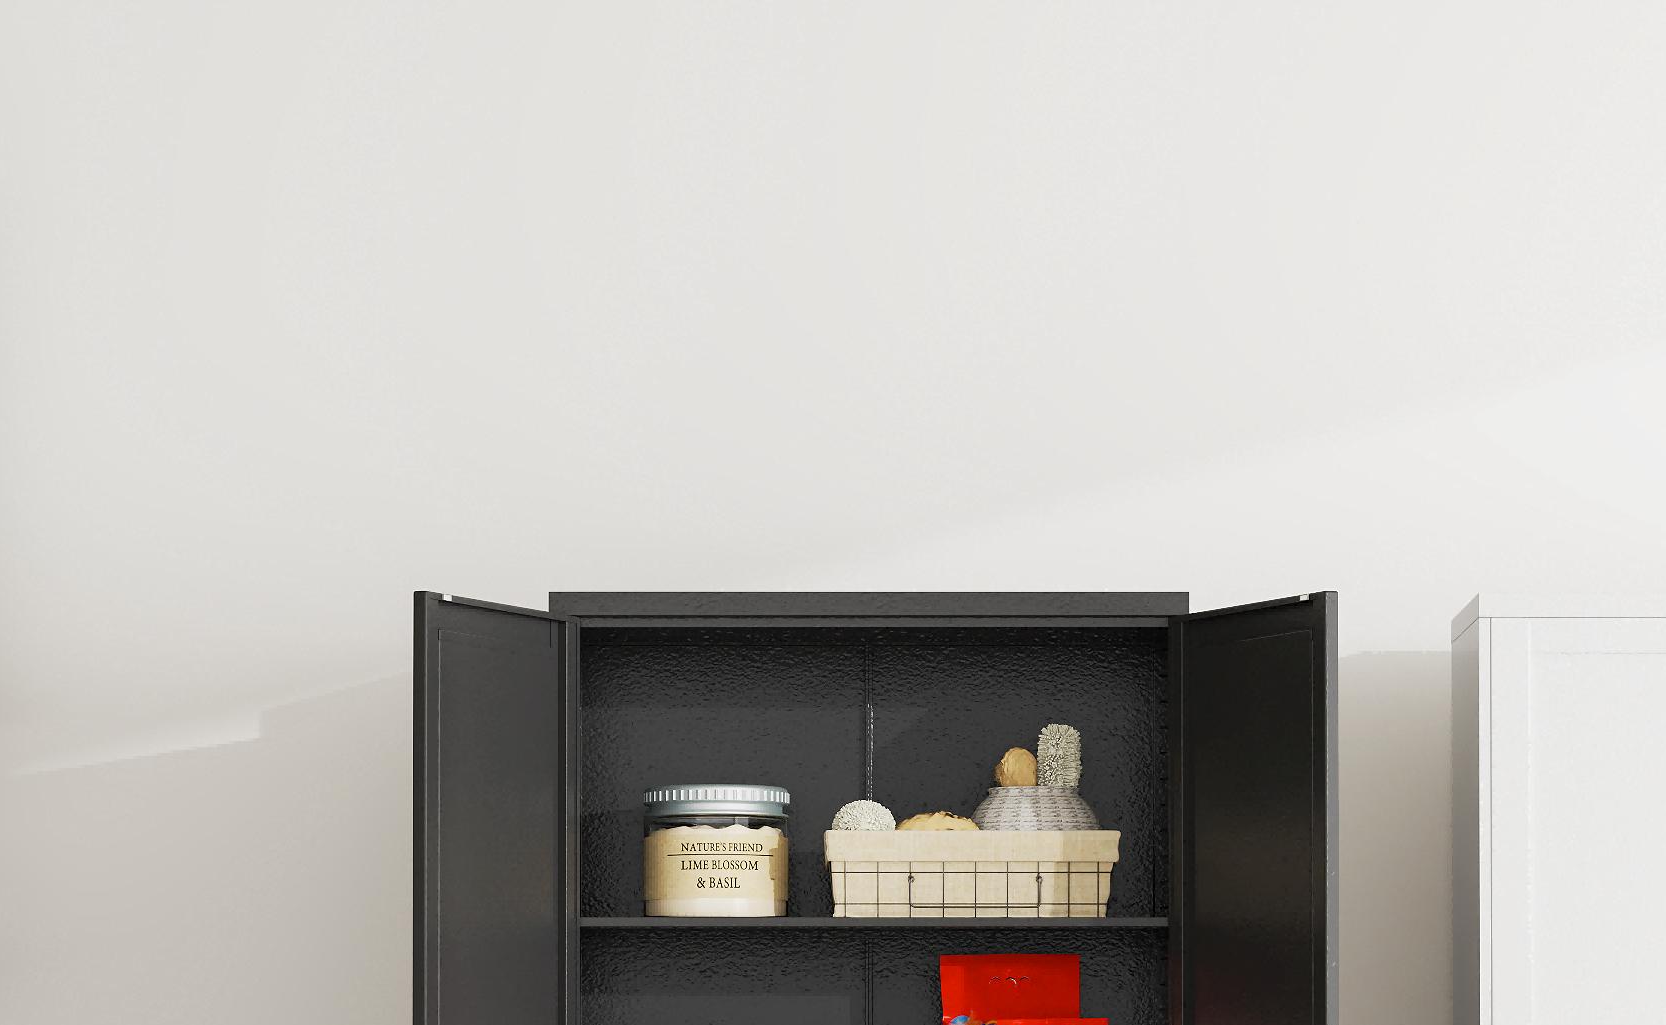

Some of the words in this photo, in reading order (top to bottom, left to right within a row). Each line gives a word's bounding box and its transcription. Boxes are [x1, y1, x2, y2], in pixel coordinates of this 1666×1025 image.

[680, 842, 727, 852] NATURE'S
[729, 842, 763, 852] FRIEND
[680, 860, 709, 871] LIME
[711, 860, 759, 871] BLOSSOM
[696, 876, 706, 889] &
[708, 876, 741, 889] BASIL
